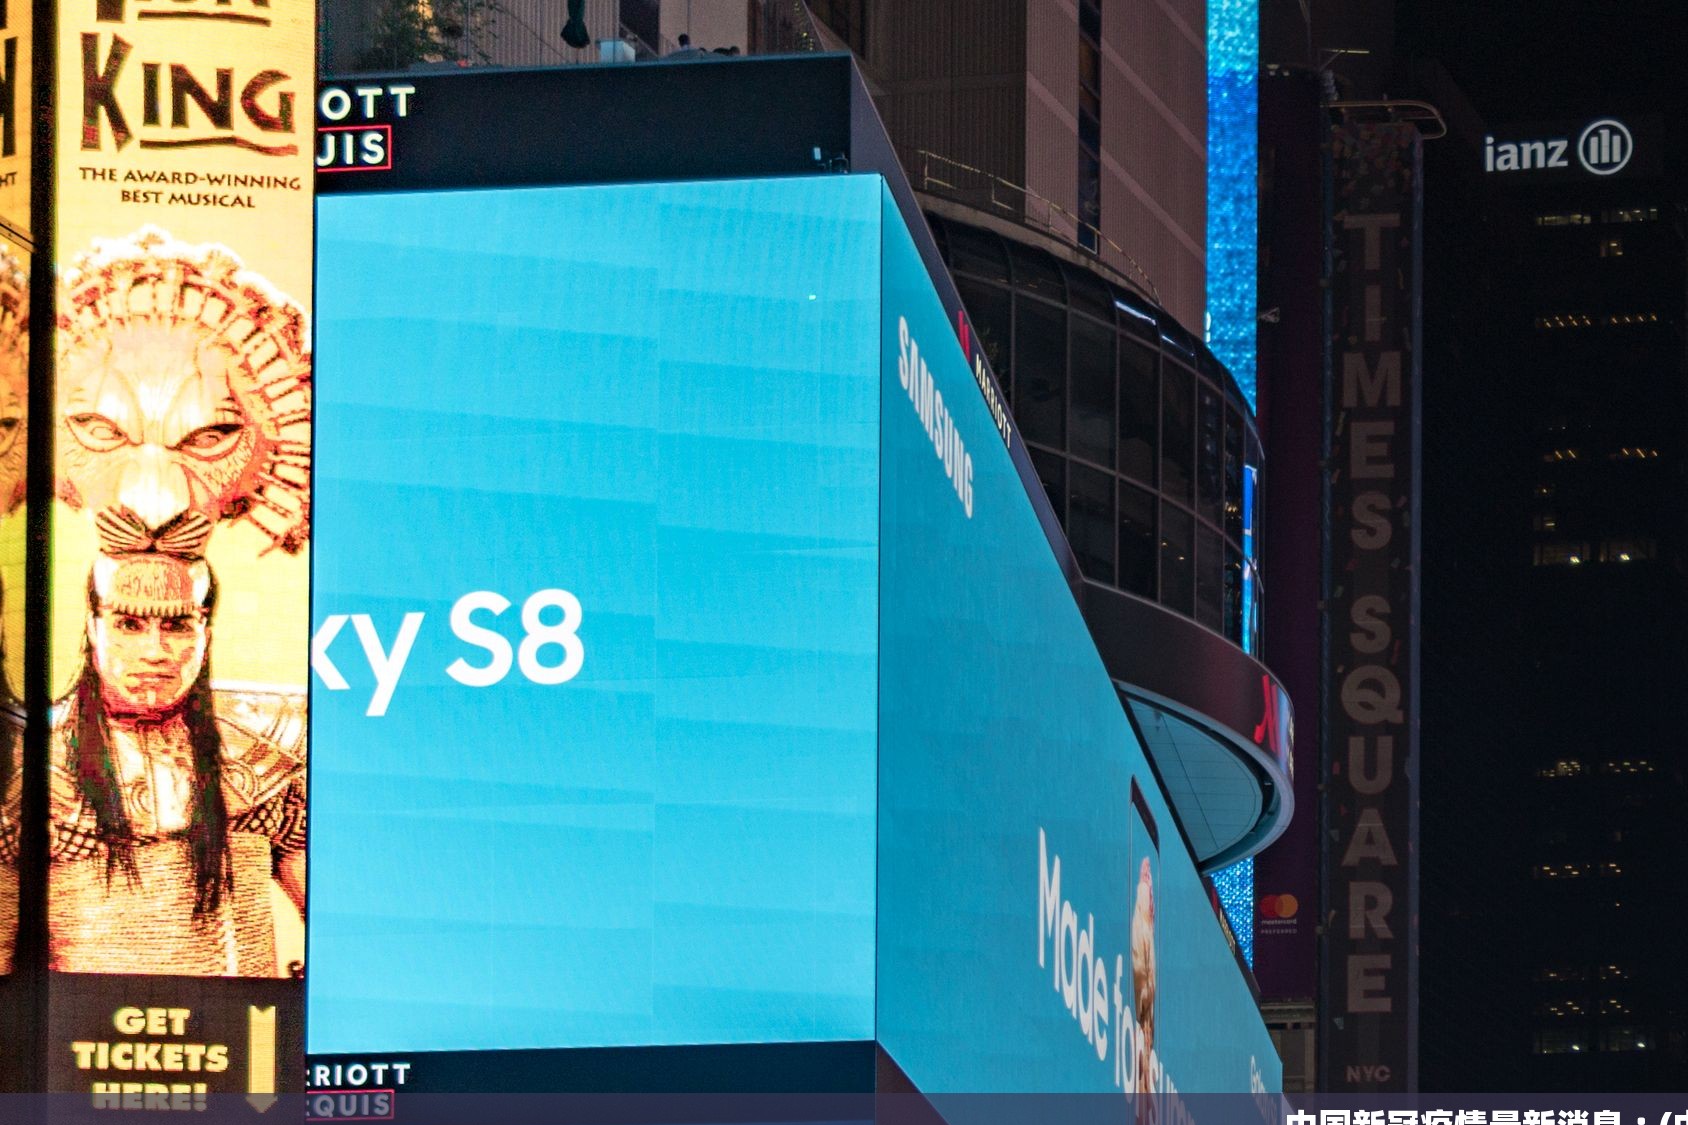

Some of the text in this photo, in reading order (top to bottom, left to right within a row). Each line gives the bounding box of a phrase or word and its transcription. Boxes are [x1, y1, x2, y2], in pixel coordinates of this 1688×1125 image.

[80, 32, 296, 152] KING
[79, 166, 302, 191] THE AWARD-WINNING
[121, 190, 256, 209] BEST MUSICAL
[899, 315, 974, 520] SAMSUNG
[976, 354, 1011, 449] MARRIOTT
[1342, 214, 1401, 550] TIMES
[445, 588, 585, 687] S8
[1340, 595, 1404, 1013] SQUARE
[1038, 826, 1109, 1062] Made
[73, 1042, 229, 1071] TICKETS
[115, 1008, 190, 1035] GET
[93, 1083, 208, 1111] HERE!
[1346, 1064, 1391, 1084] NYC
